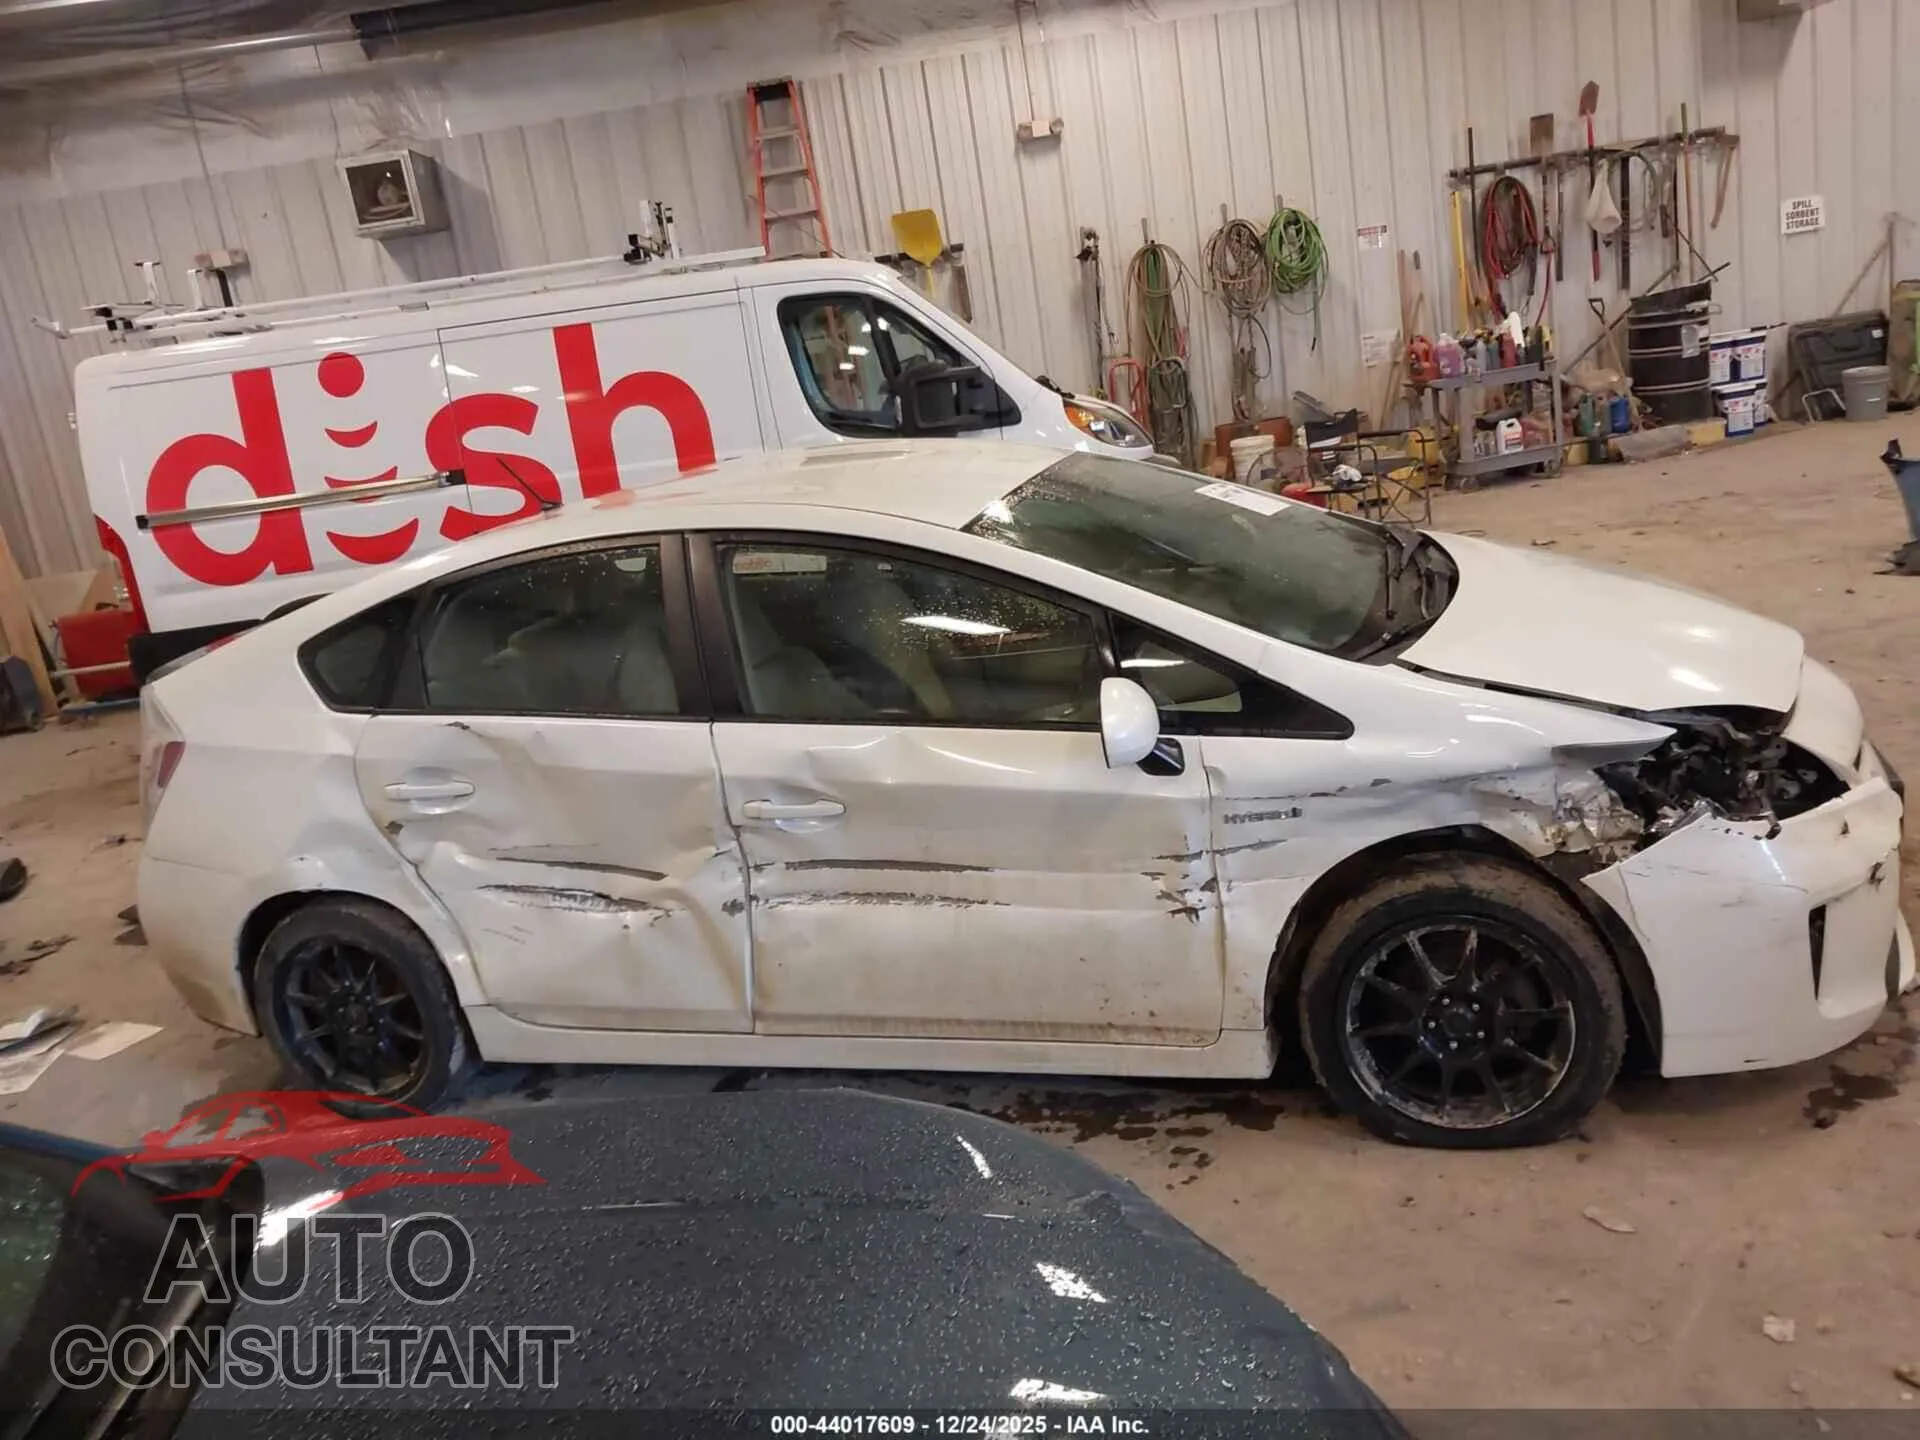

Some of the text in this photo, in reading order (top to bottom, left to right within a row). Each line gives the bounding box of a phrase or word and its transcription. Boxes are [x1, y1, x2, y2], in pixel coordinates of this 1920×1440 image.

[1792, 200, 1812, 210] SPILL
[1786, 217, 1820, 230] STORAGE
[146, 322, 717, 586] dish
